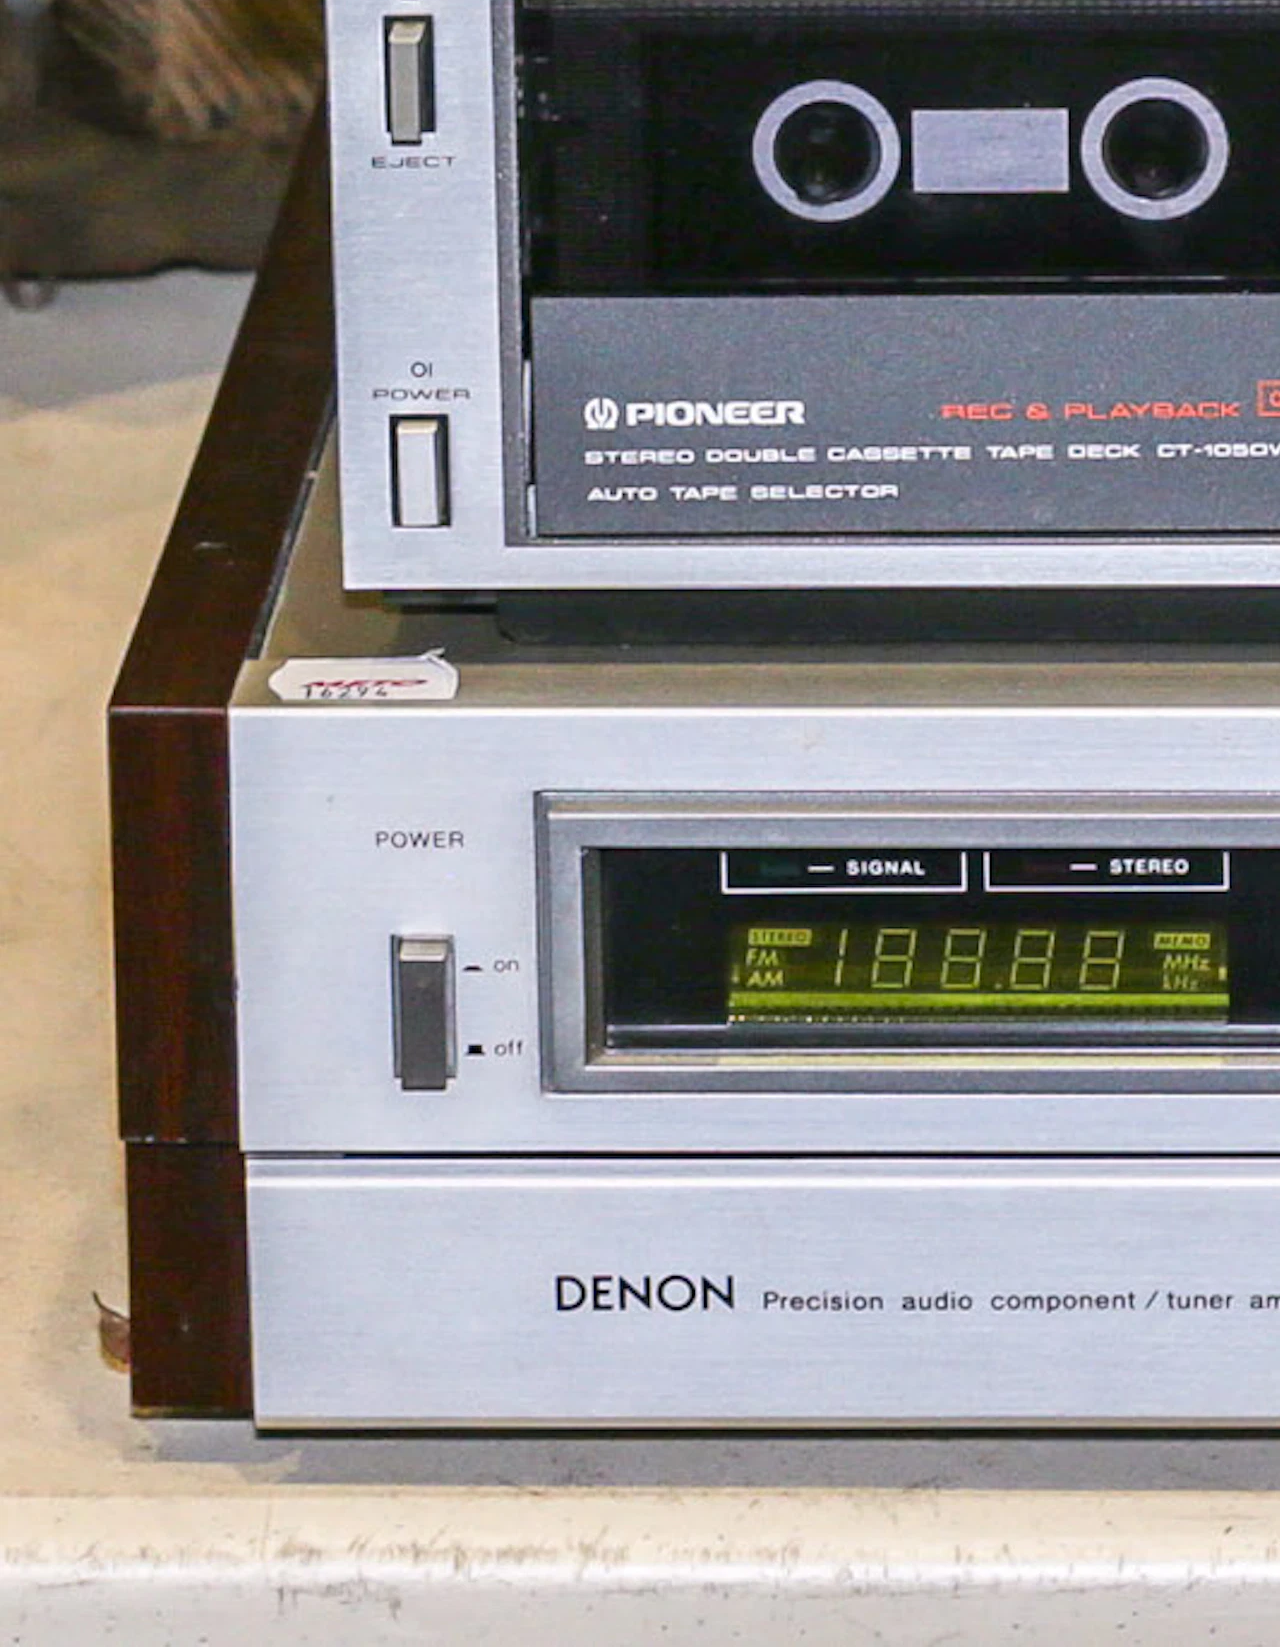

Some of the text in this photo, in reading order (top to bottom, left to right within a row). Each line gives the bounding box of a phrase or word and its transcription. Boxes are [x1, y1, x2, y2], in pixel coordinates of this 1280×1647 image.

[370, 155, 455, 170] EJECT
[371, 388, 471, 401] POWER
[626, 400, 805, 427] PIONEER
[940, 401, 1240, 420] REC & PLAYBACK
[584, 449, 695, 465] STEREO
[705, 447, 816, 463] DOUBLE
[827, 446, 971, 462] CASSETTE
[985, 444, 1053, 460] TAPE
[1067, 443, 1141, 459] DECK
[587, 484, 899, 501] AUTO TAPE SELECTOR
[375, 830, 464, 849] POWER
[846, 859, 926, 876] SIGNAL
[1109, 858, 1190, 875] STEREO
[746, 950, 778, 965] FM
[1163, 954, 1210, 971] MHz
[493, 959, 520, 974] on
[747, 971, 783, 987] AM
[494, 1040, 523, 1057] off
[555, 1274, 734, 1312] DENON
[763, 1290, 884, 1312] Precision
[901, 1291, 973, 1311] audio
[990, 1291, 1136, 1314] component
[1166, 1292, 1233, 1310] tuner
